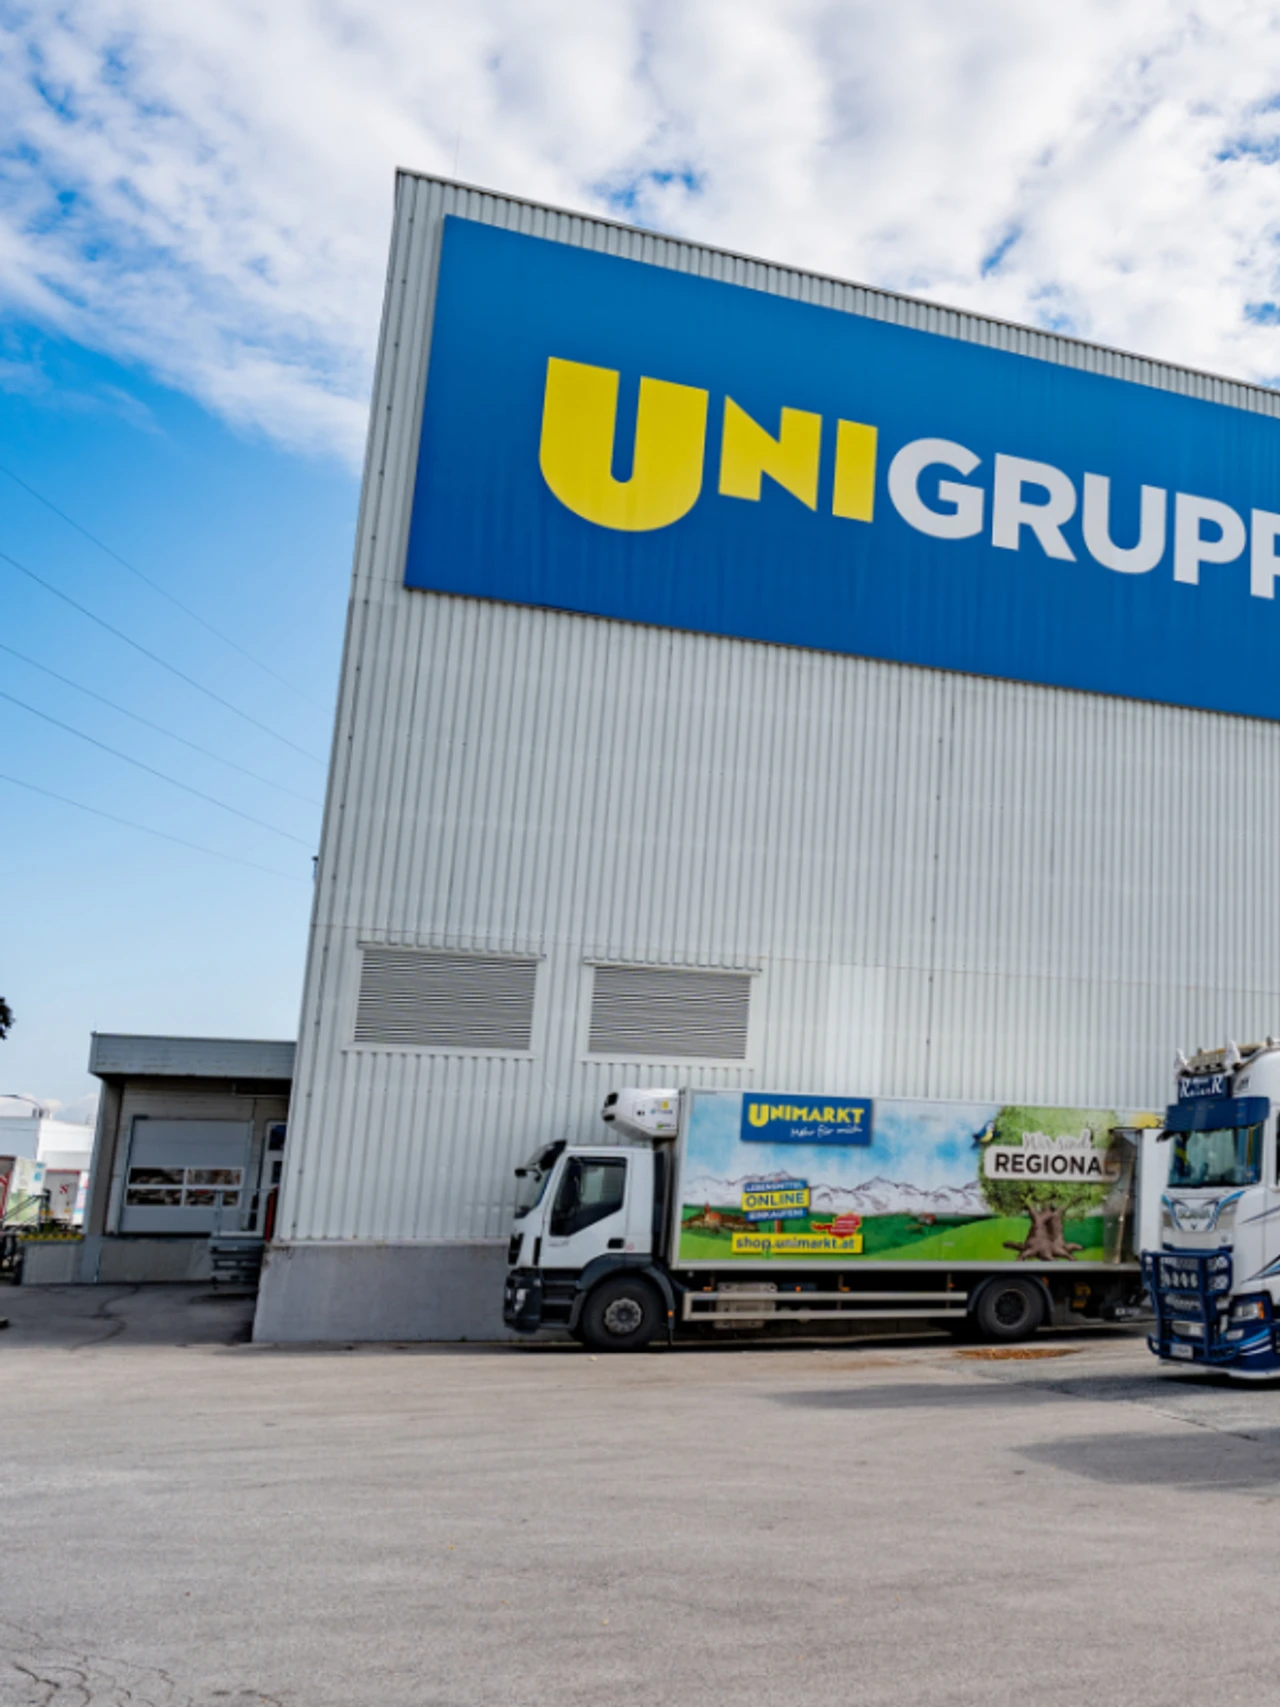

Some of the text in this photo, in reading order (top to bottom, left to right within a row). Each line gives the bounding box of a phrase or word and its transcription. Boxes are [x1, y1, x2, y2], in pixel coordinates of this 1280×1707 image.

[748, 1103, 865, 1128] UNIMARKT
[745, 1191, 805, 1208] ONLINE
[736, 1236, 855, 1251] shop.unimarkt.at
